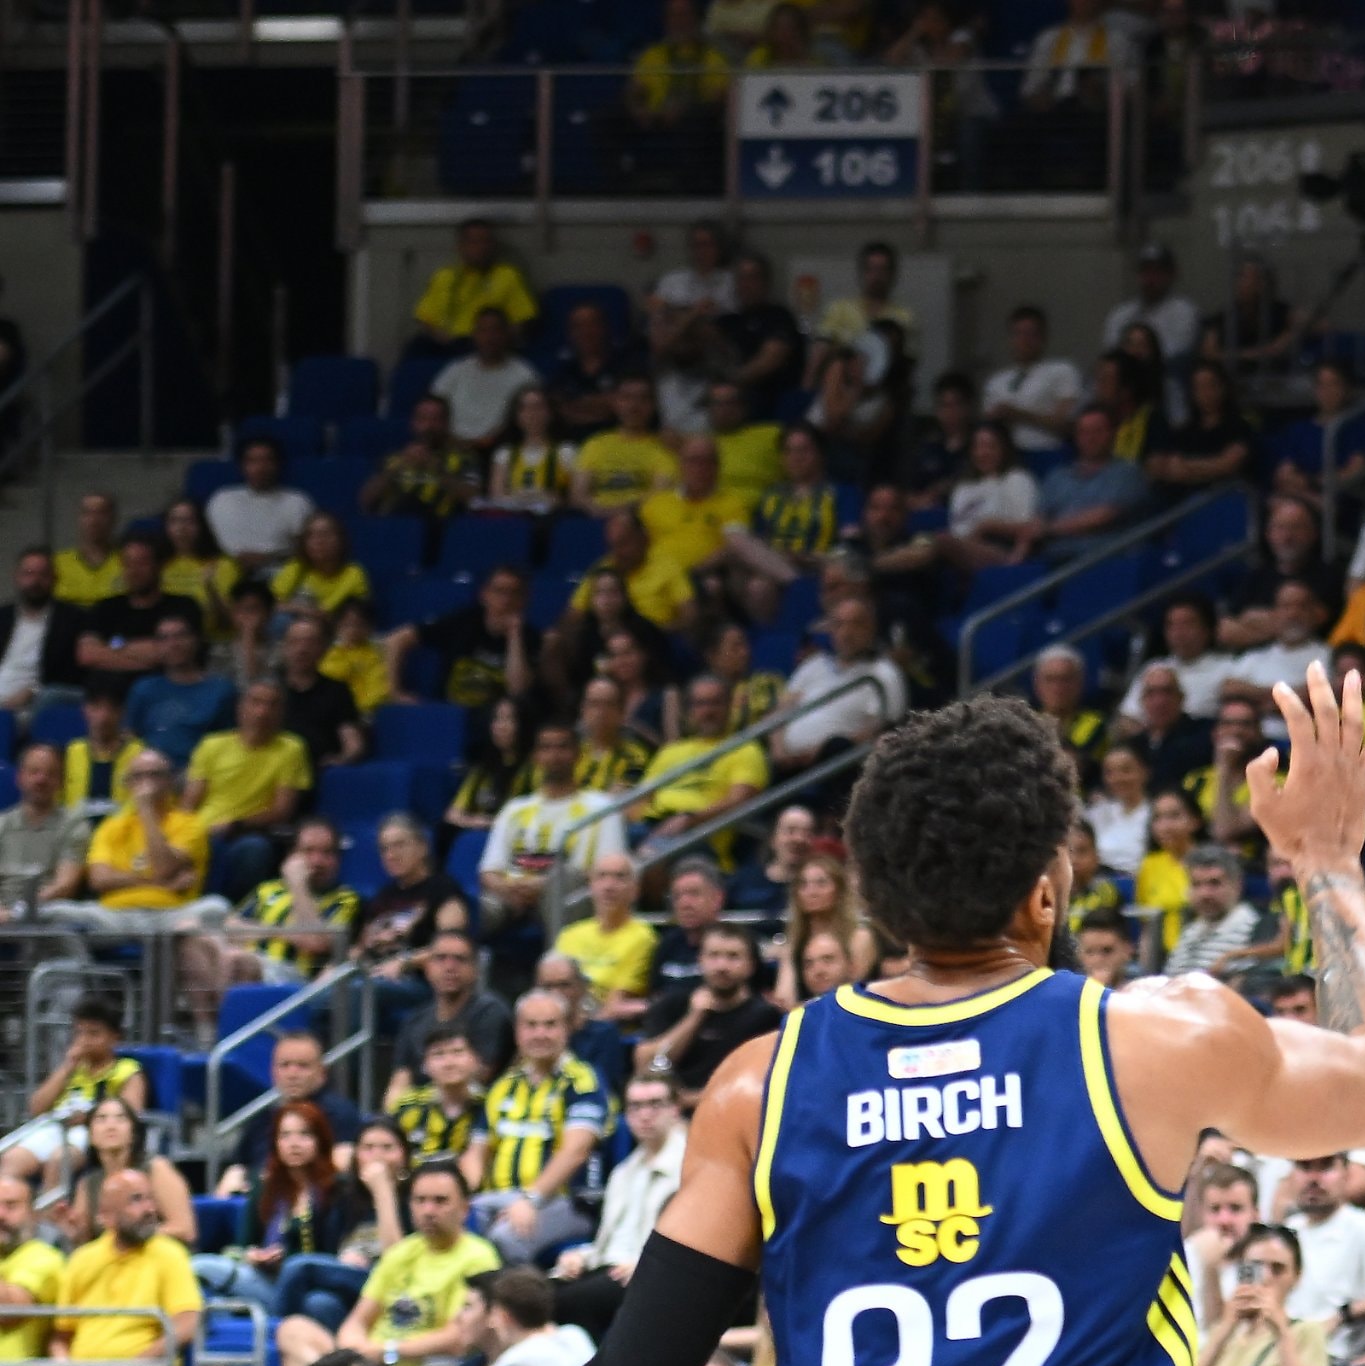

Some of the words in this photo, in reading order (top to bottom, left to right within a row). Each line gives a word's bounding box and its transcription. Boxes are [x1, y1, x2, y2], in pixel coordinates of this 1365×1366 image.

[815, 86, 898, 123] 206
[815, 150, 898, 187] 106
[847, 1072, 1023, 1148] BIRCH
